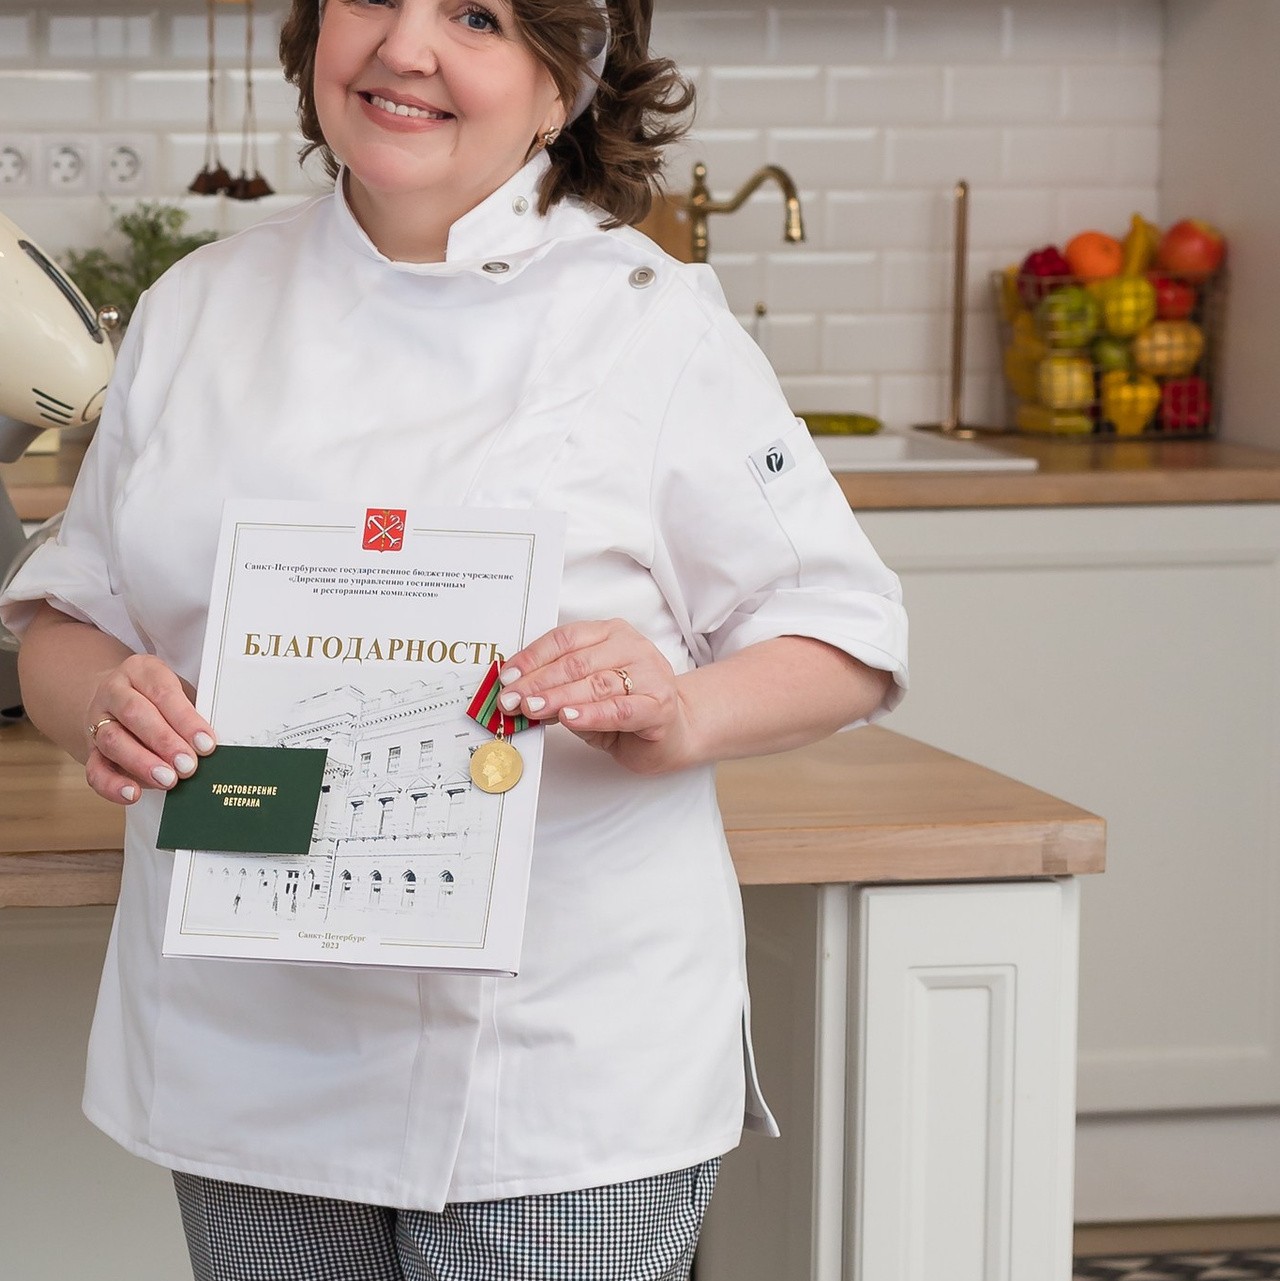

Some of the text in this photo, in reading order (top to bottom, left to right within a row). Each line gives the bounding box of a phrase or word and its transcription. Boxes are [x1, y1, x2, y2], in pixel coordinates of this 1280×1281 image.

[244, 562, 514, 581] Санкт-Петербургское государственное бюджетное учреждение
[288, 575, 336, 584] «Дирекция
[350, 579, 404, 587] управлению
[320, 588, 378, 596] ресторанным
[380, 590, 439, 598] комплексом»
[243, 633, 506, 666] БЛАГОДАРНОСТЬ
[212, 784, 278, 796] УДОСТОВЕРЕНИЕ
[223, 796, 261, 807] ВЕТЕРАНА
[298, 931, 366, 943] Санкт-Петербург
